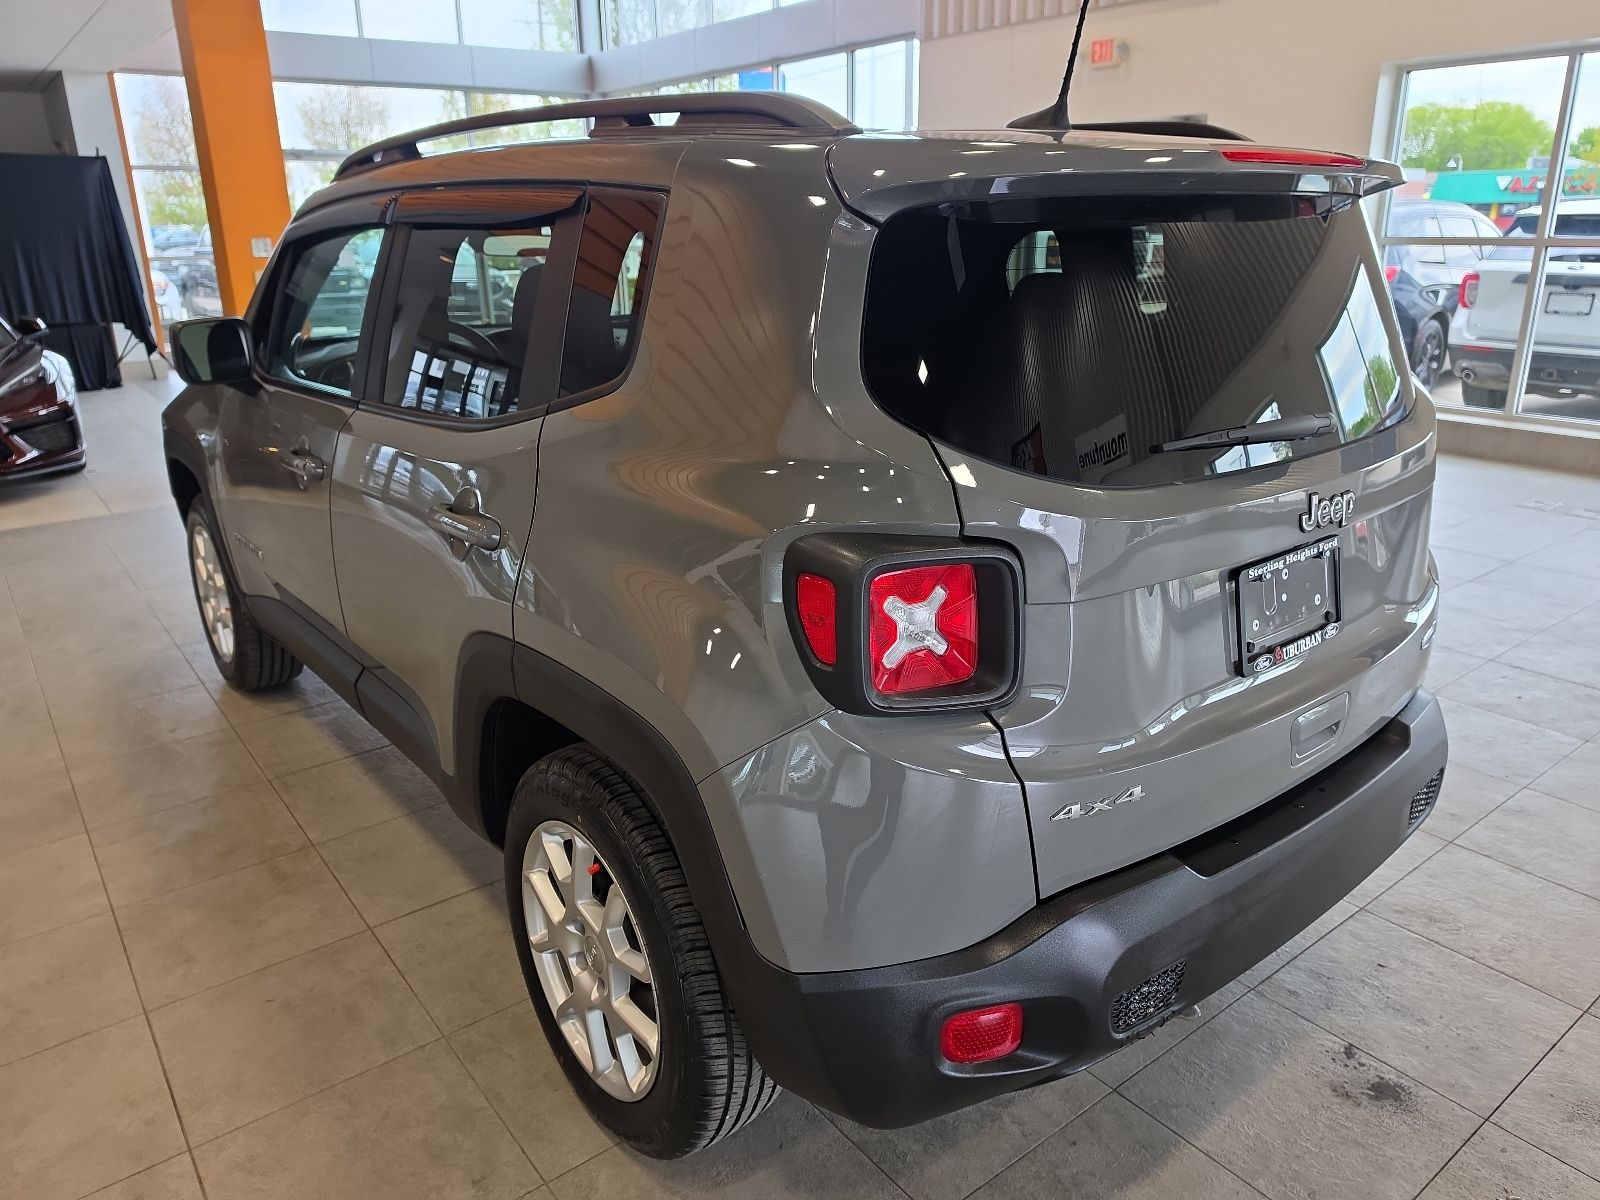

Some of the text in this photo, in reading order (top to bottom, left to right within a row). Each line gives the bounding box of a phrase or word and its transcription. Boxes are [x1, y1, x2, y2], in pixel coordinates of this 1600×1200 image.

[1299, 490, 1356, 533] Jeep
[1248, 538, 1338, 579] Sterling Heights Ford
[1274, 630, 1322, 665] SUBURBAN
